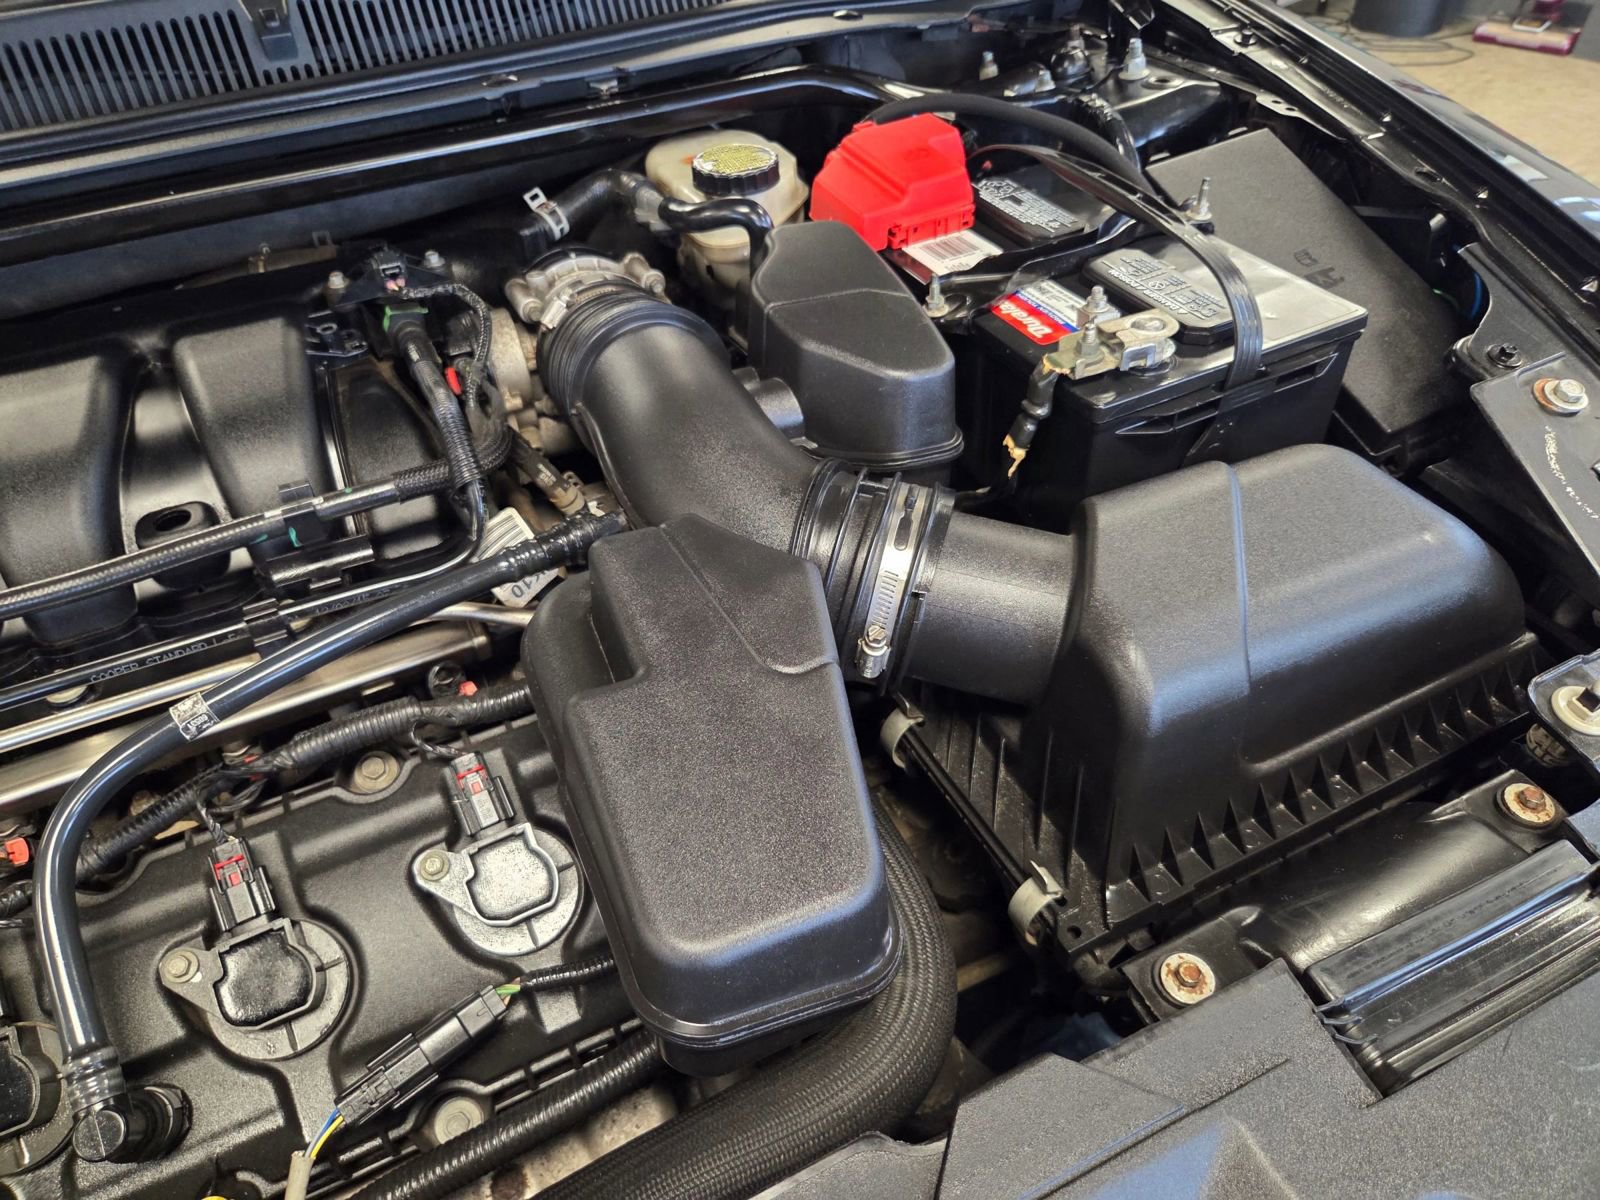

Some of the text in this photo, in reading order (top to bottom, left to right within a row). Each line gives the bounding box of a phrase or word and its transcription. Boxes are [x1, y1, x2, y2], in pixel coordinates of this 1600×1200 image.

[1108, 268, 1138, 290] POISON
[1143, 289, 1180, 311] DANGER
[998, 300, 1054, 339] Durala
[90, 661, 139, 683] COOPER
[145, 641, 208, 666] STANDARD
